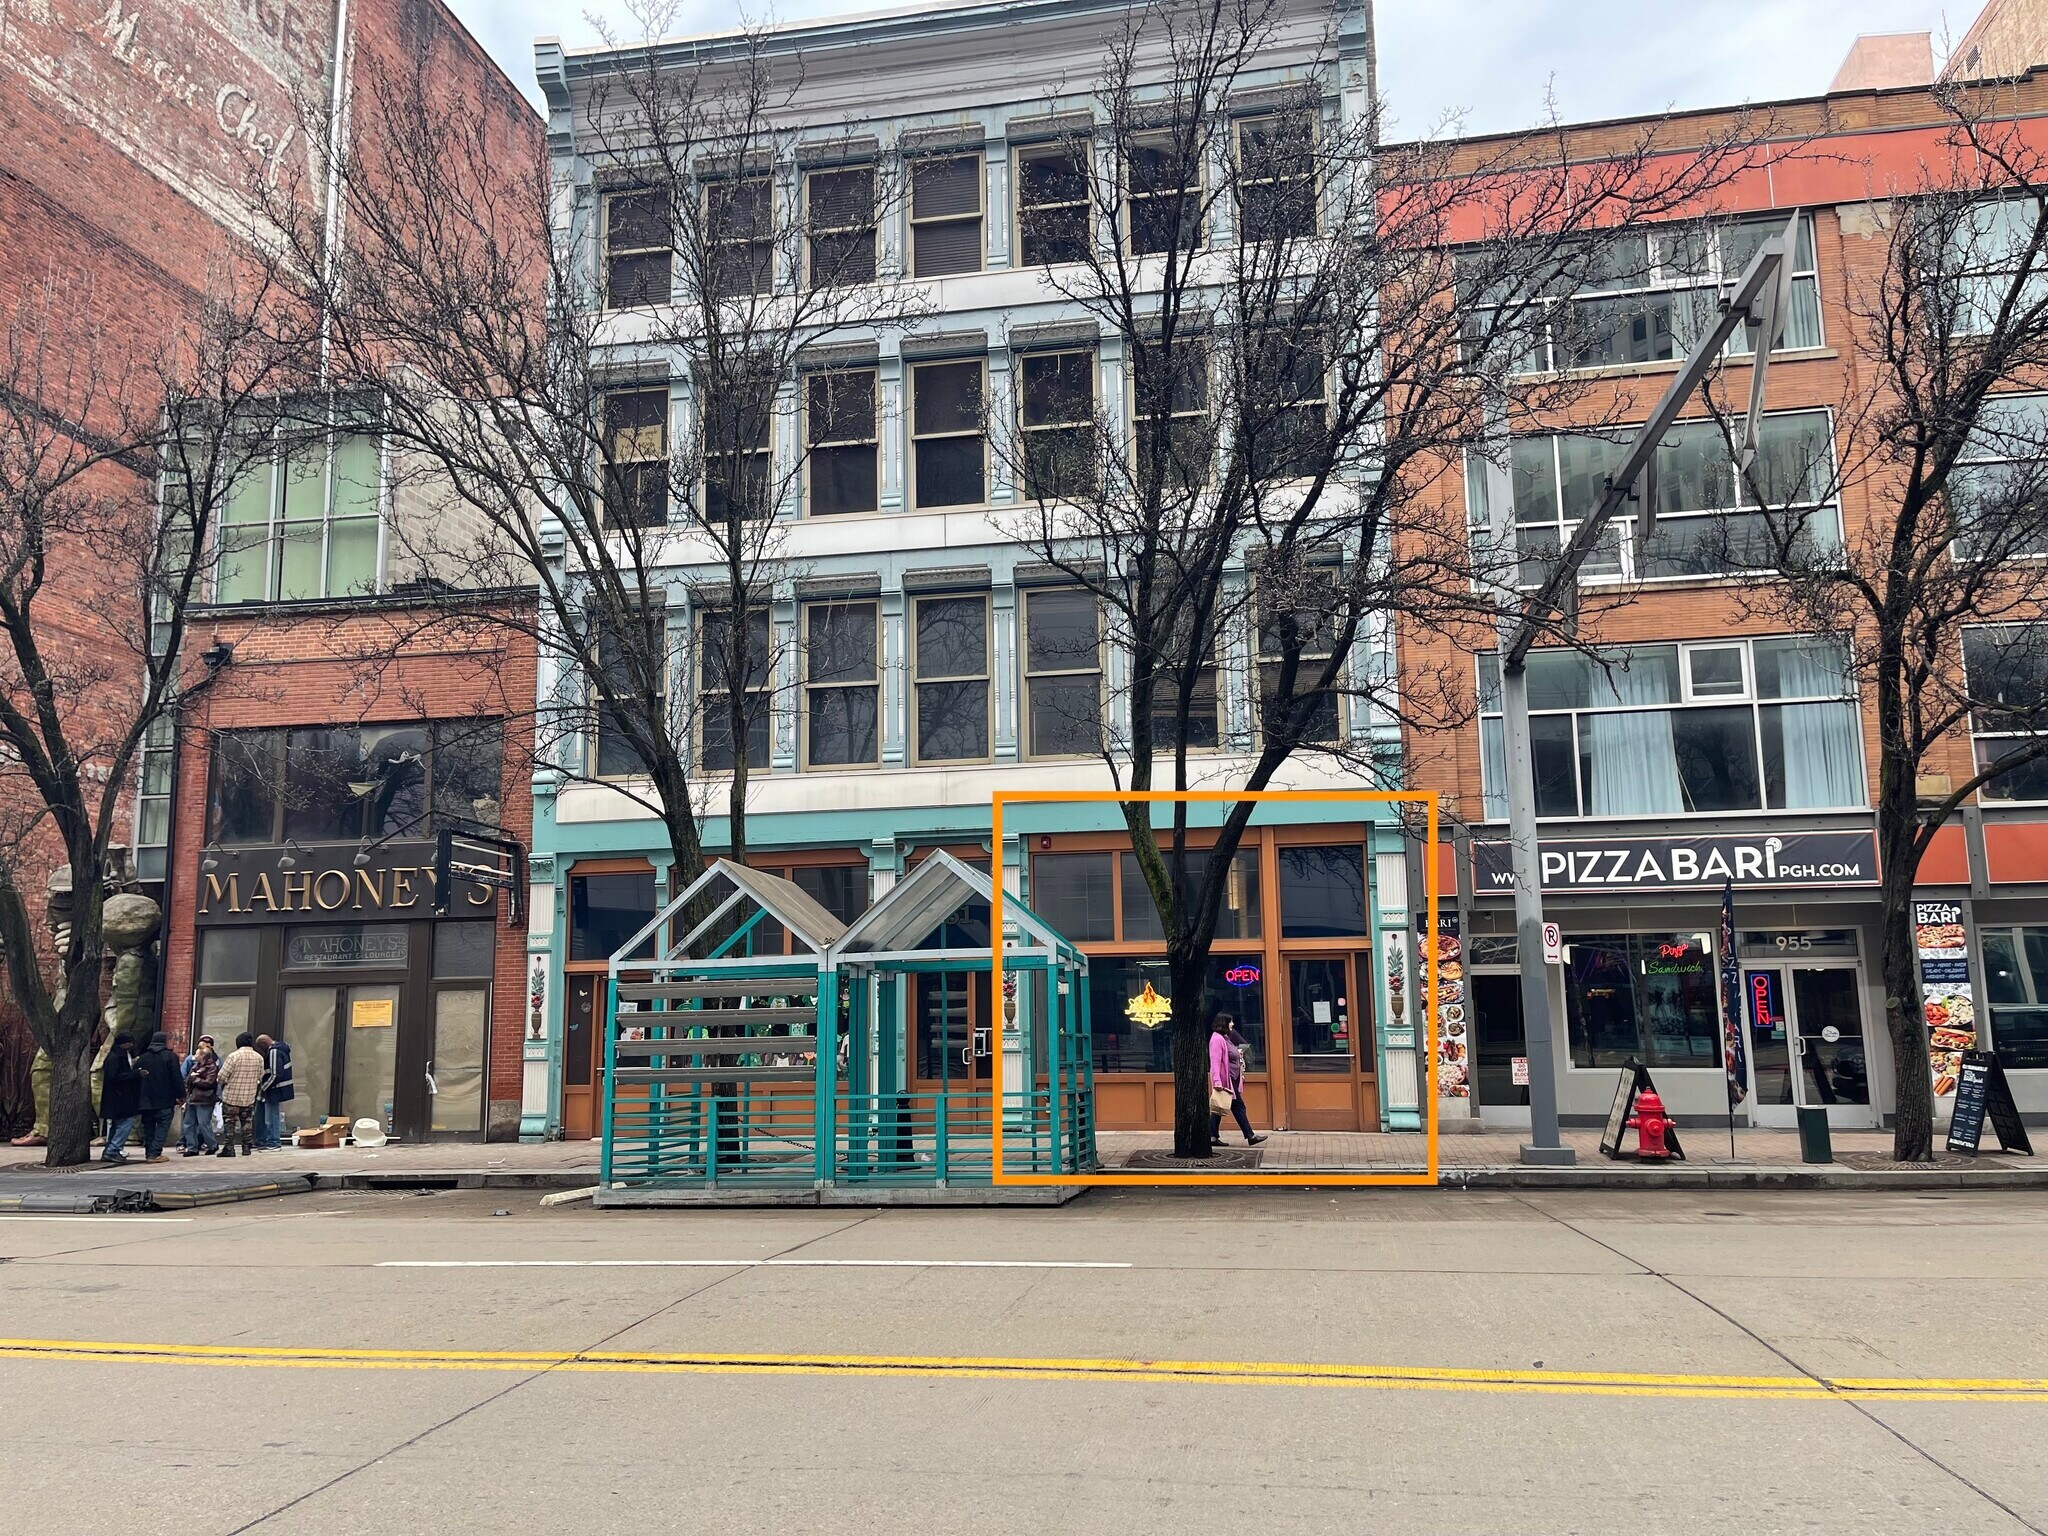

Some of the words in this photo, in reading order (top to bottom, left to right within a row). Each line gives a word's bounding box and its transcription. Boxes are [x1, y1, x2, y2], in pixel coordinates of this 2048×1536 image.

[1916, 904, 1951, 913] PIZZA
[1917, 911, 1957, 924] BARI
[1776, 936, 1812, 951] 955
[304, 953, 353, 961] RESTAURANT
[1648, 961, 1704, 974] Sandwich
[1225, 969, 1259, 981] OPEN
[1753, 976, 1770, 1025] OPEN
